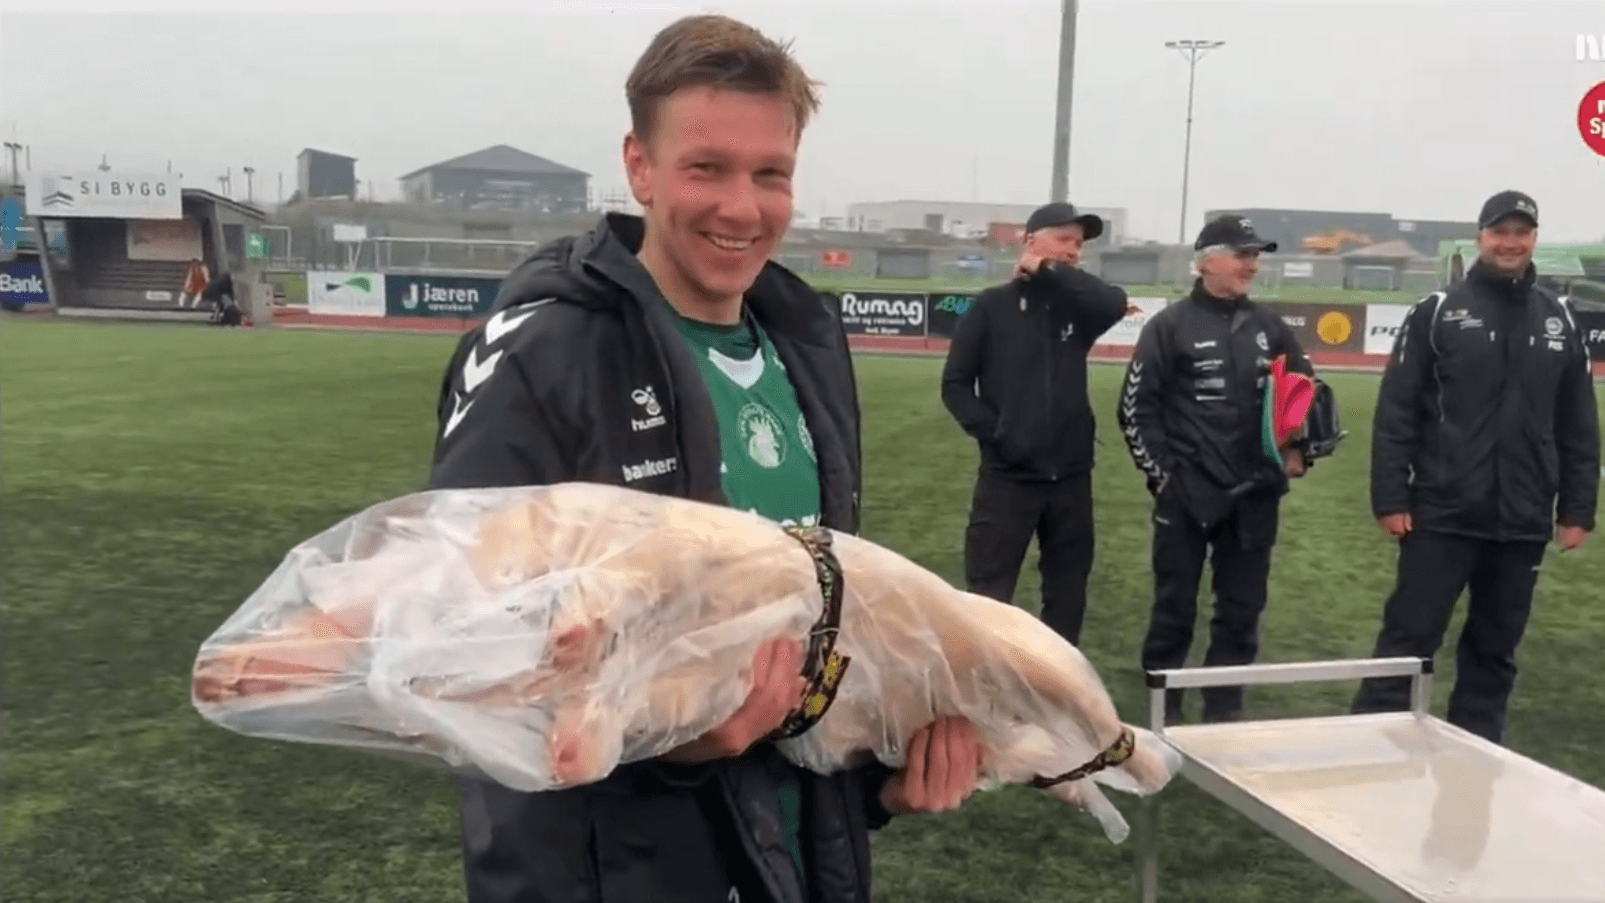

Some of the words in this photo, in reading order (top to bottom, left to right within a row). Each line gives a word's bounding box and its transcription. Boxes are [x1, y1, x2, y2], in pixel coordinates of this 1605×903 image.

[111, 181, 167, 196] BYGG
[0, 274, 43, 294] Bank
[424, 283, 479, 302] jæren
[842, 293, 923, 325] Rumag
